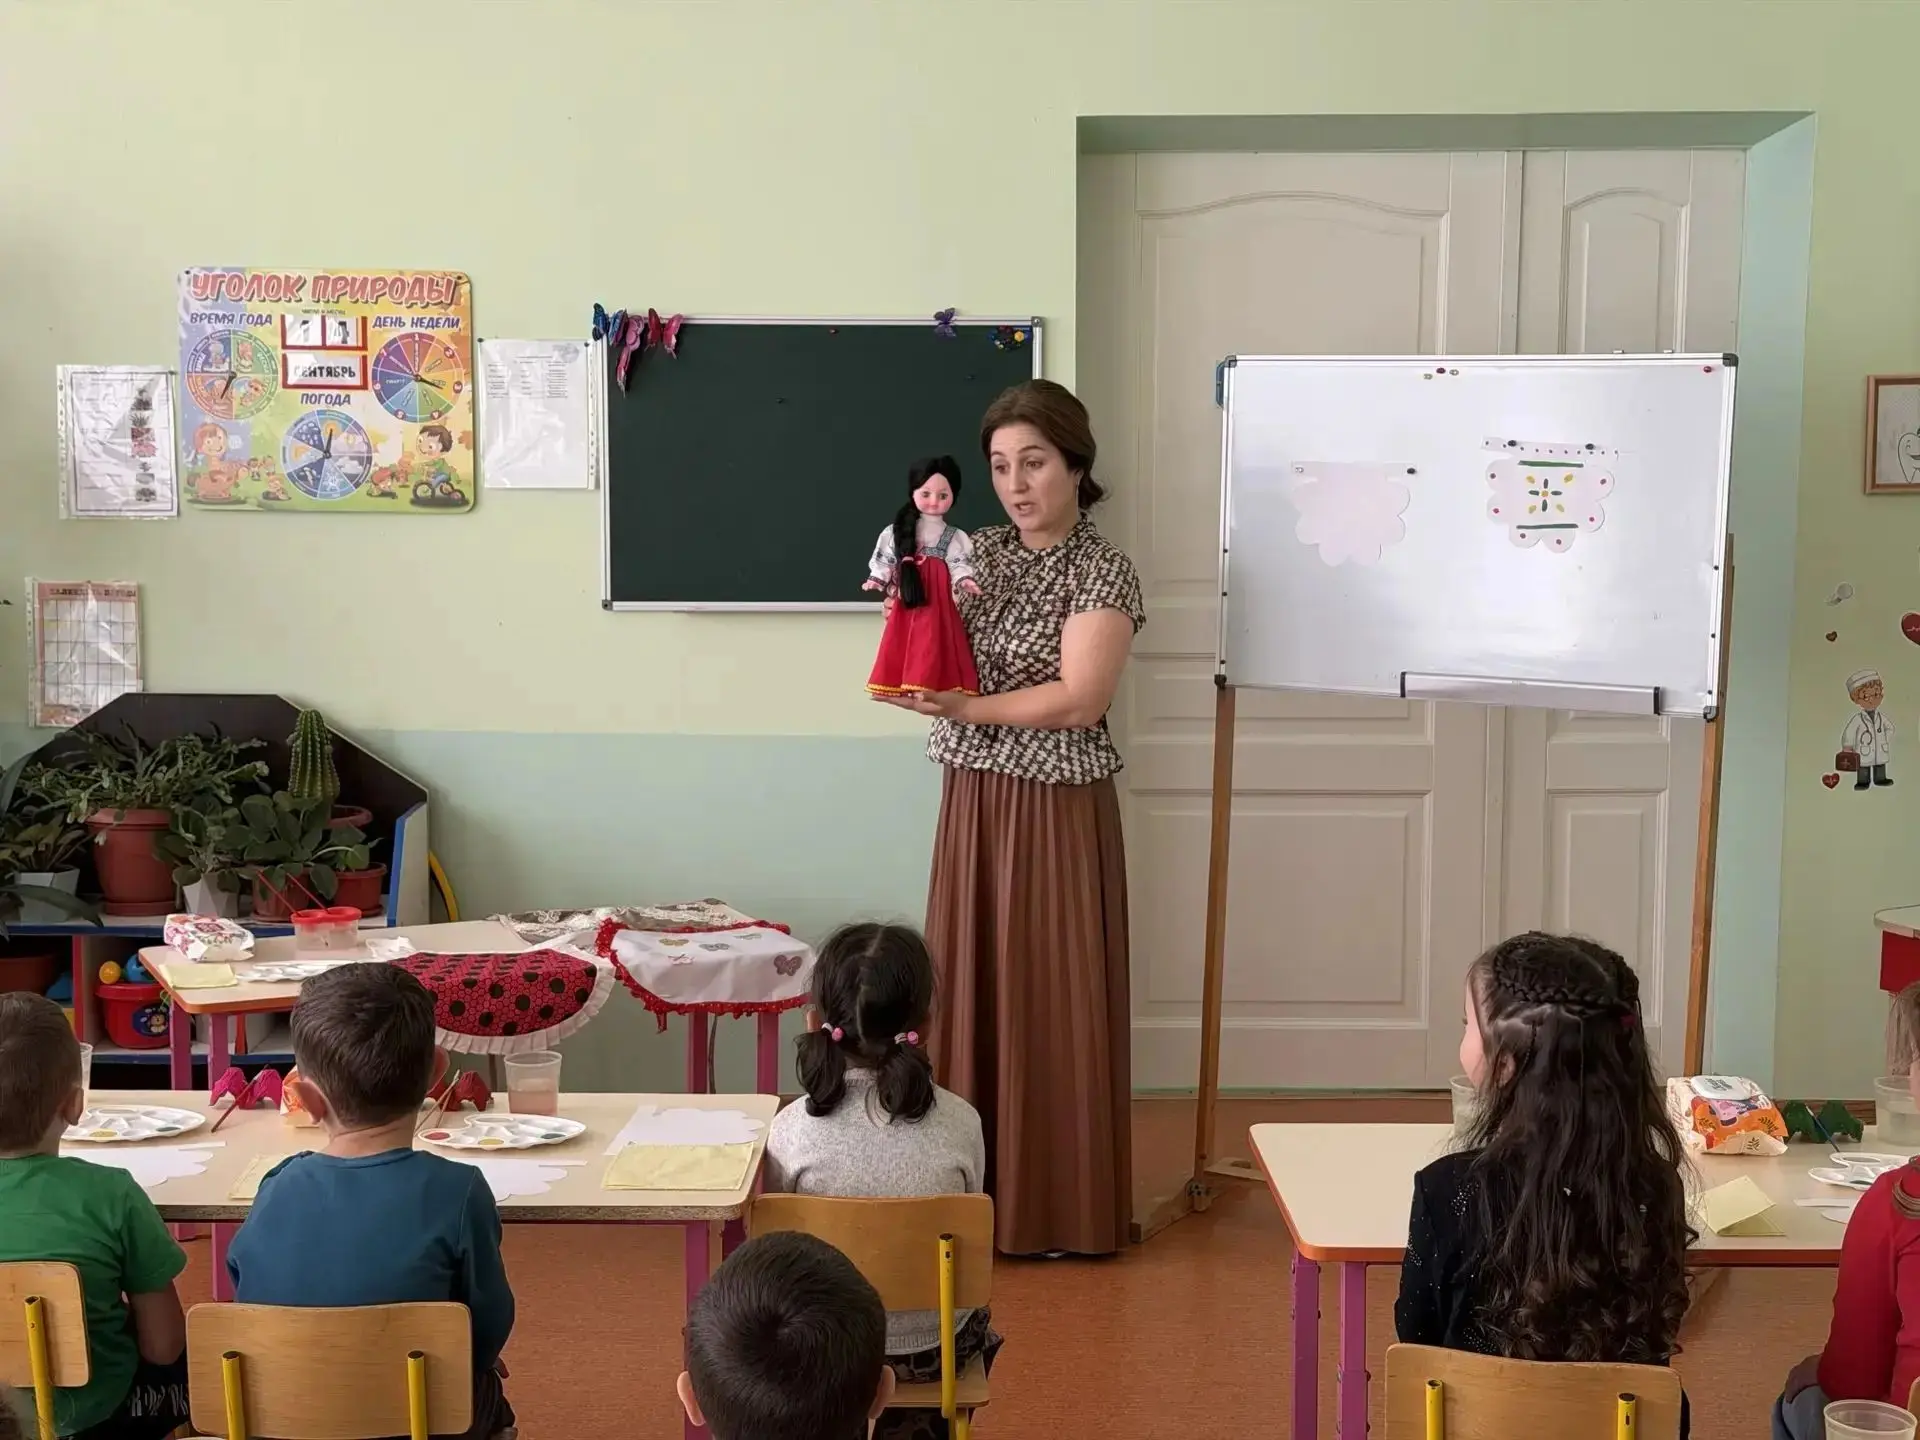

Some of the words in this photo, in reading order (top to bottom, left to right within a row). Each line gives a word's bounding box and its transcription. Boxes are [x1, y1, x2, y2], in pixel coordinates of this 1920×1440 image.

[191, 272, 305, 302] УГОЛОК
[311, 274, 456, 307] ПРИРОДЫ
[190, 312, 235, 325] ВРЕМЯ
[239, 313, 273, 326] ГОДА
[372, 316, 406, 329] ДЕНЬ
[410, 316, 460, 329] НЕДЕЛИ
[300, 393, 352, 406] ПОГОДА
